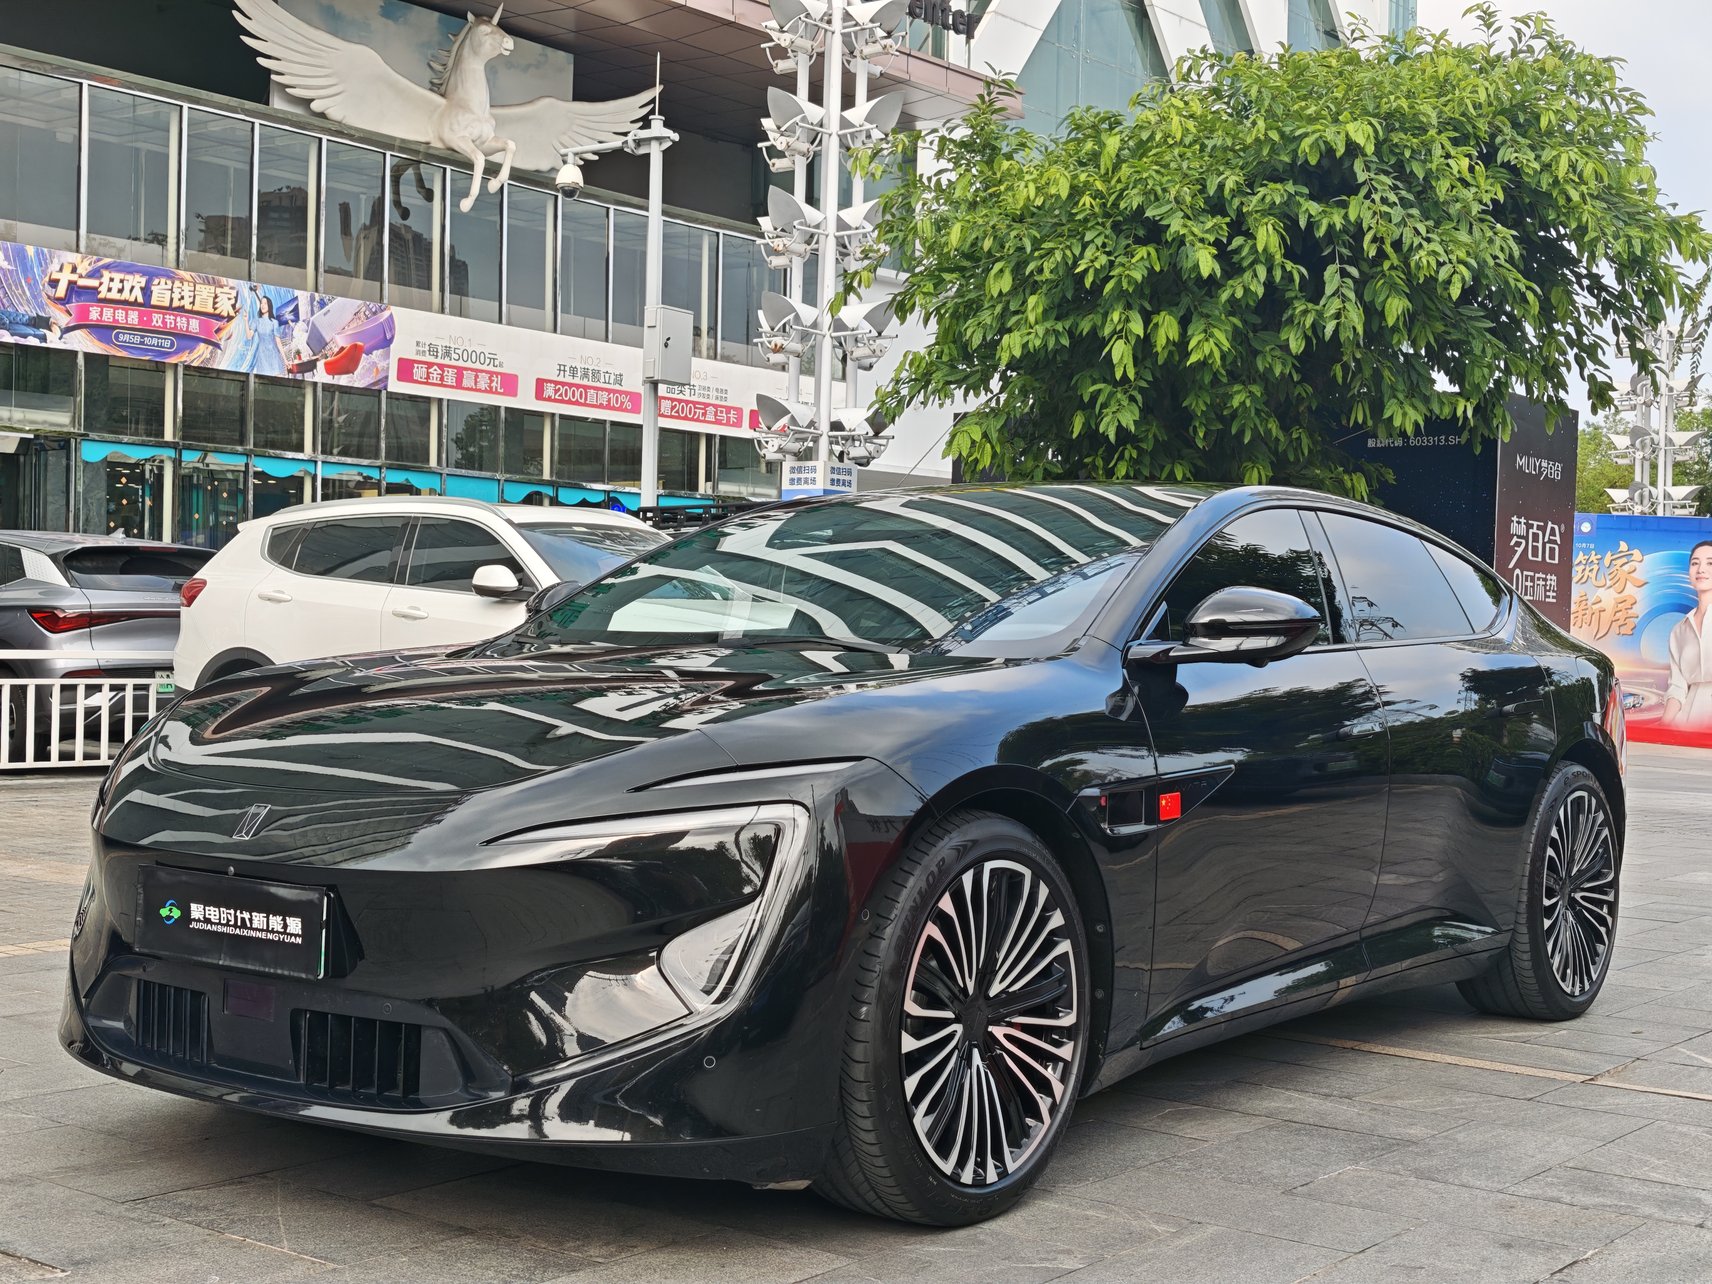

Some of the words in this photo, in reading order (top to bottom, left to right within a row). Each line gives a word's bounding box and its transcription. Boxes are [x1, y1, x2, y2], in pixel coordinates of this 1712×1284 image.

[50, 263, 147, 304] 十一狂欢
[151, 278, 240, 318] 省钱置家
[580, 355, 601, 367] NO.2
[413, 363, 457, 386] 砸金蛋
[462, 370, 504, 393] 赢豪礼
[556, 363, 624, 387] 开单满额立减
[692, 370, 708, 381] O.3
[788, 465, 817, 475] 微信扫码
[788, 477, 817, 486] 缴费离场
[829, 465, 853, 477] 微信扫码
[829, 477, 852, 488] 缴费离场
[1573, 540, 1649, 594] 筑家
[1571, 589, 1639, 641] 新居
[189, 902, 302, 935] 聚电时代新能源
[189, 921, 302, 944] JUDIANSHIDAIXINNENGYUAN
